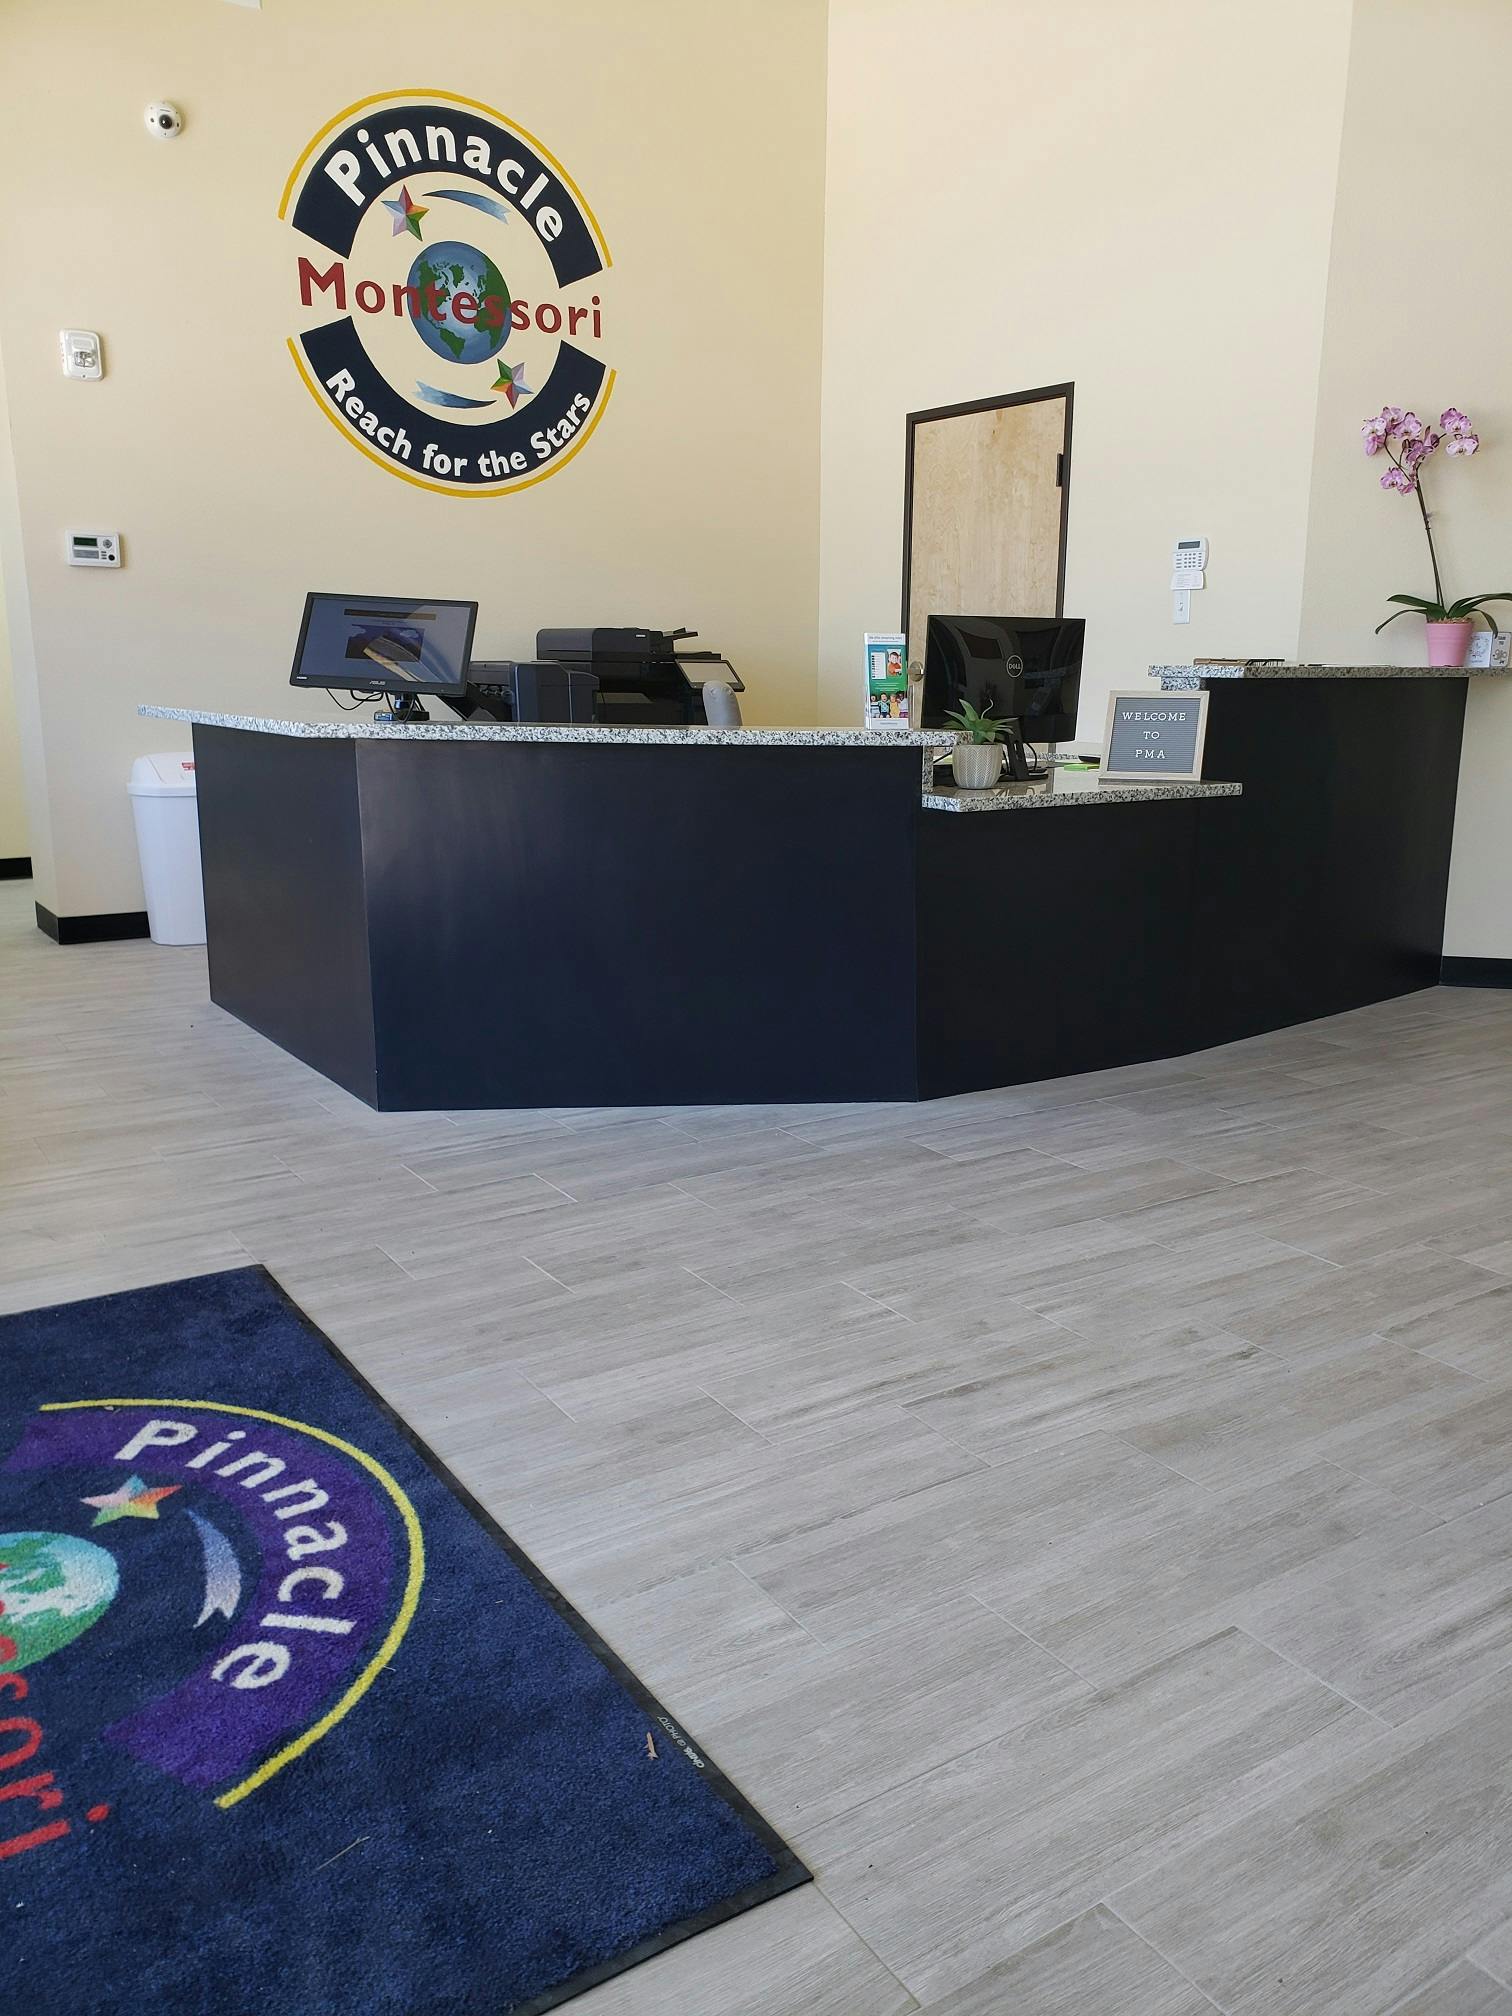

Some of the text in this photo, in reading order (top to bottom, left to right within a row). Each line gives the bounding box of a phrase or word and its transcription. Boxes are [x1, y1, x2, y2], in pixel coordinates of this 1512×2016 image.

[324, 125, 563, 242] Pinnacle
[297, 257, 602, 339] Montessori
[325, 368, 592, 478] Reach for the Stars
[1122, 711, 1187, 721] WELCOME
[1135, 749, 1166, 759] PMA
[1143, 731, 1160, 740] TO
[114, 1420, 358, 1690] Pinnacle
